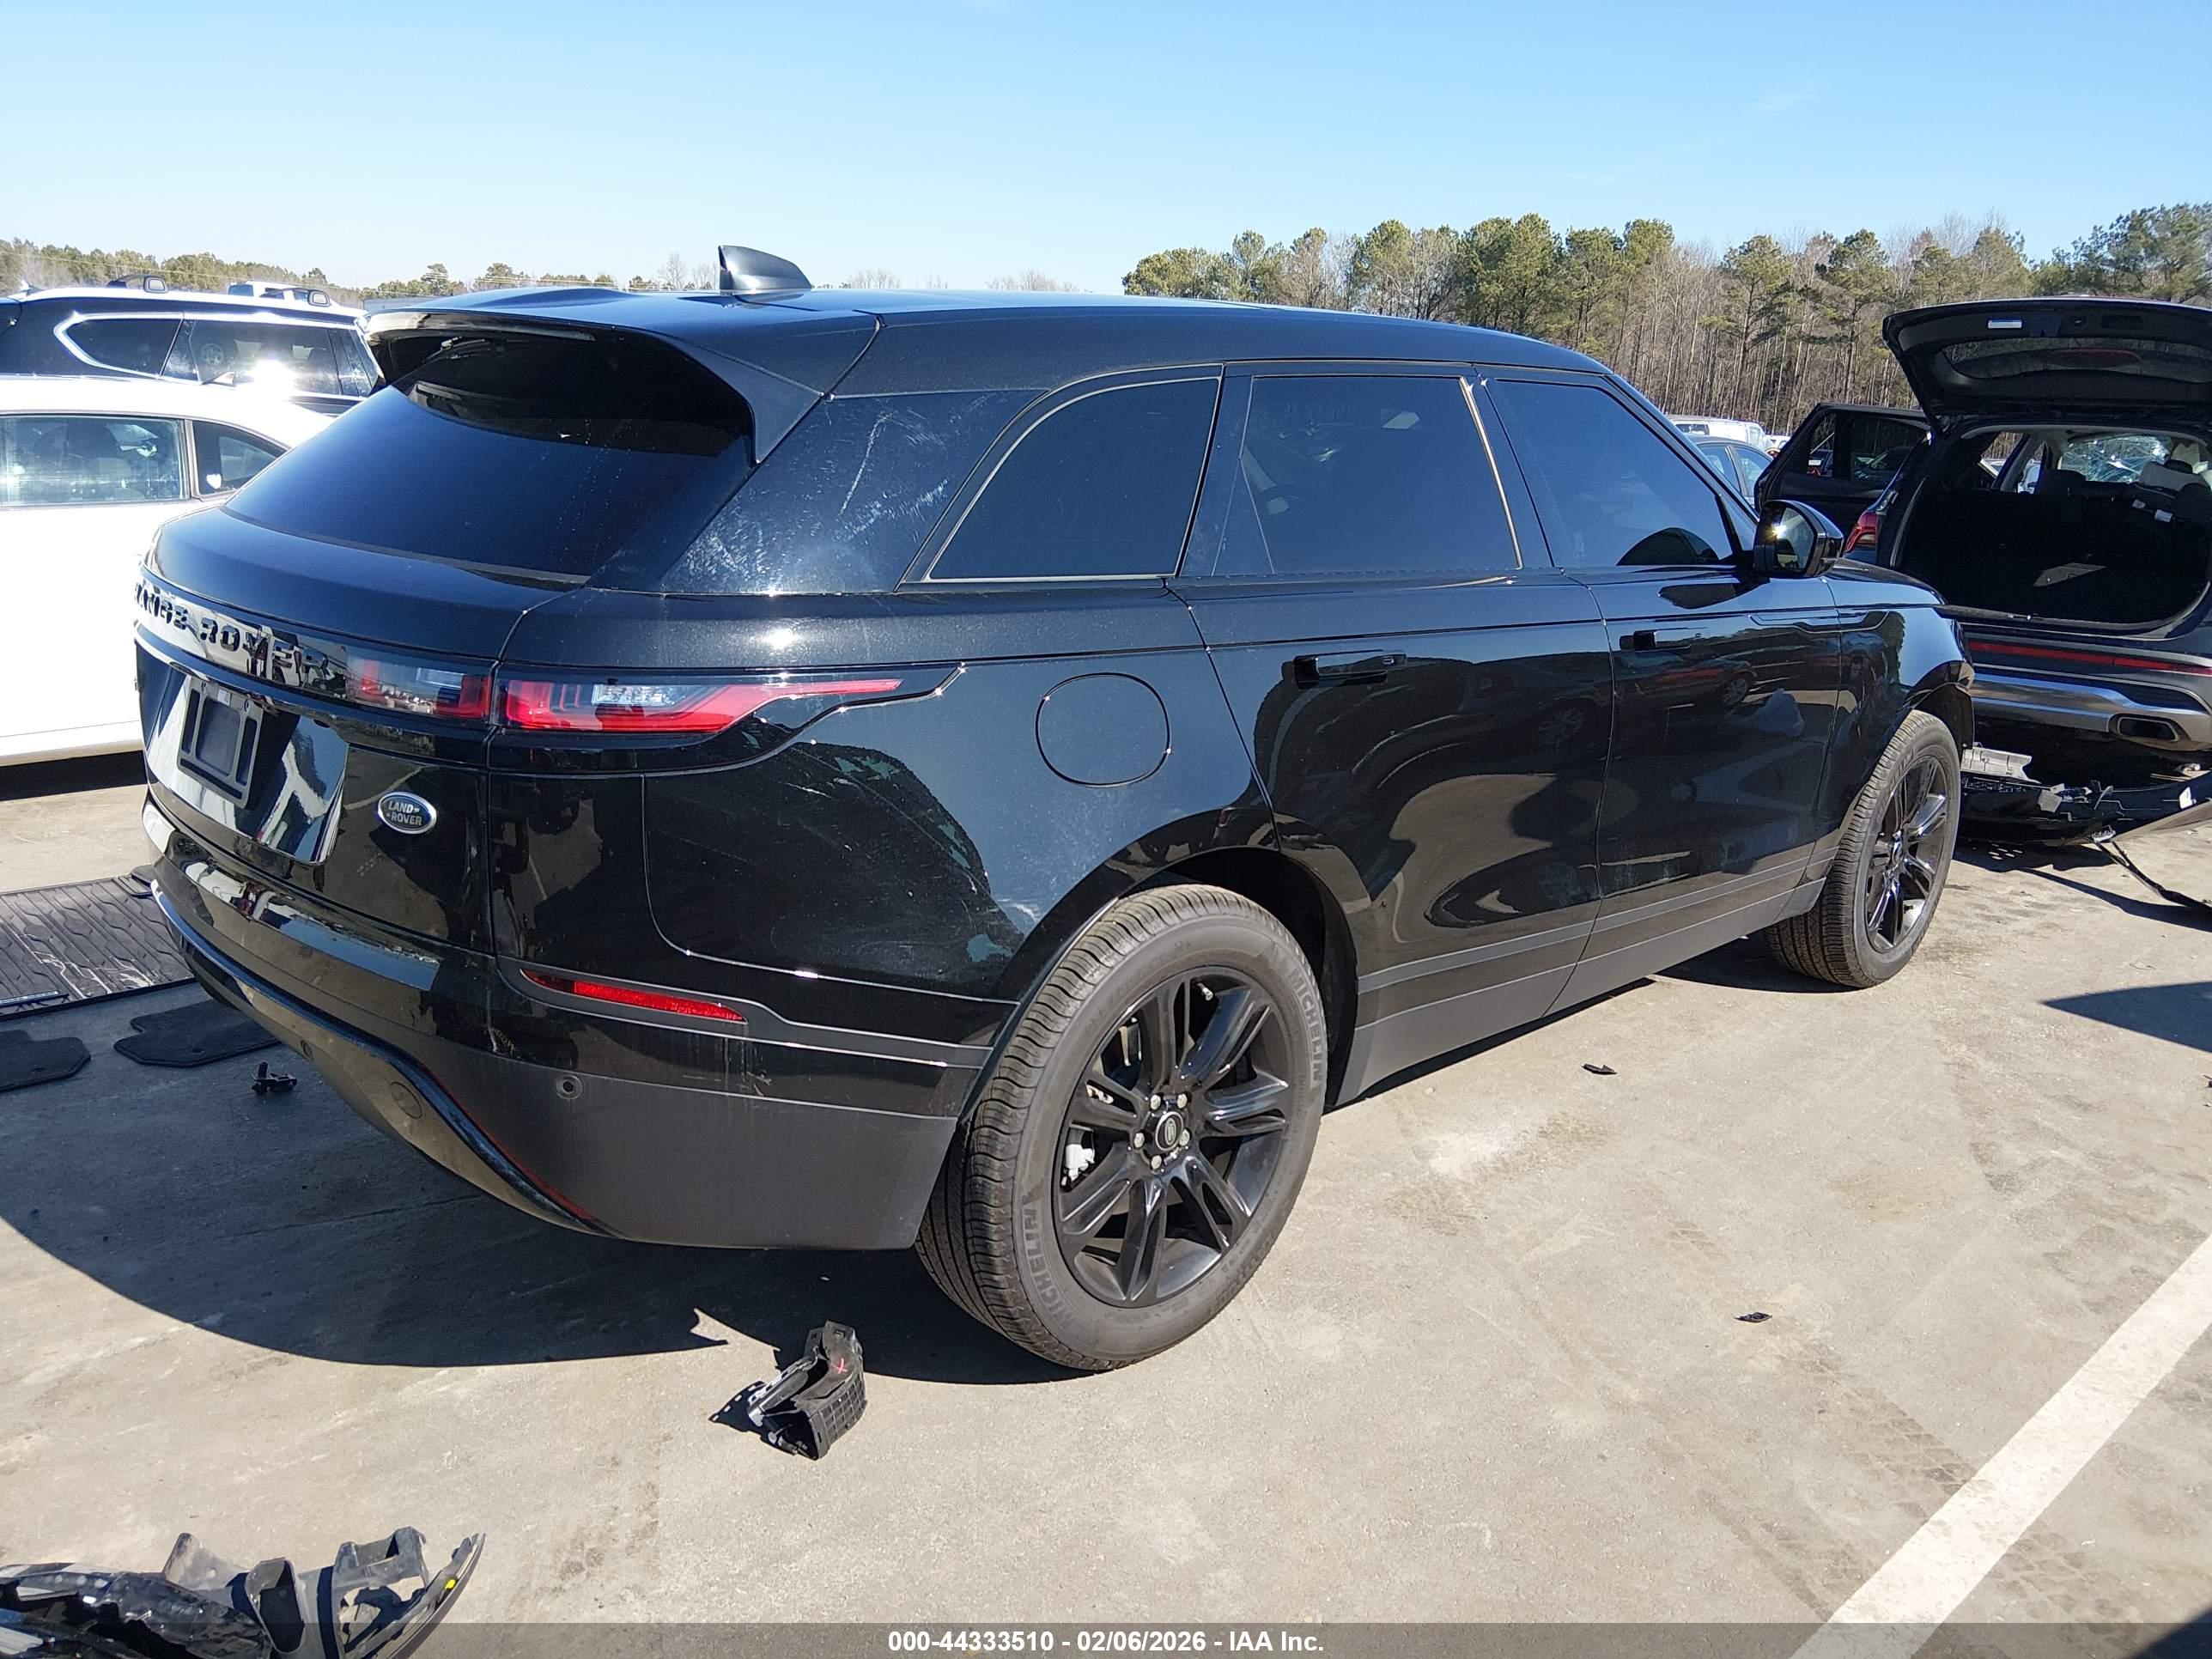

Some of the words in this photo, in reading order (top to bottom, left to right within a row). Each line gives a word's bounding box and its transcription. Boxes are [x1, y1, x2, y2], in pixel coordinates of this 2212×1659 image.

[199, 617, 331, 680] ROVER
[388, 800, 415, 814] LAND
[391, 811, 422, 826] ROVER
[1287, 965, 1323, 1087] MICHELIN
